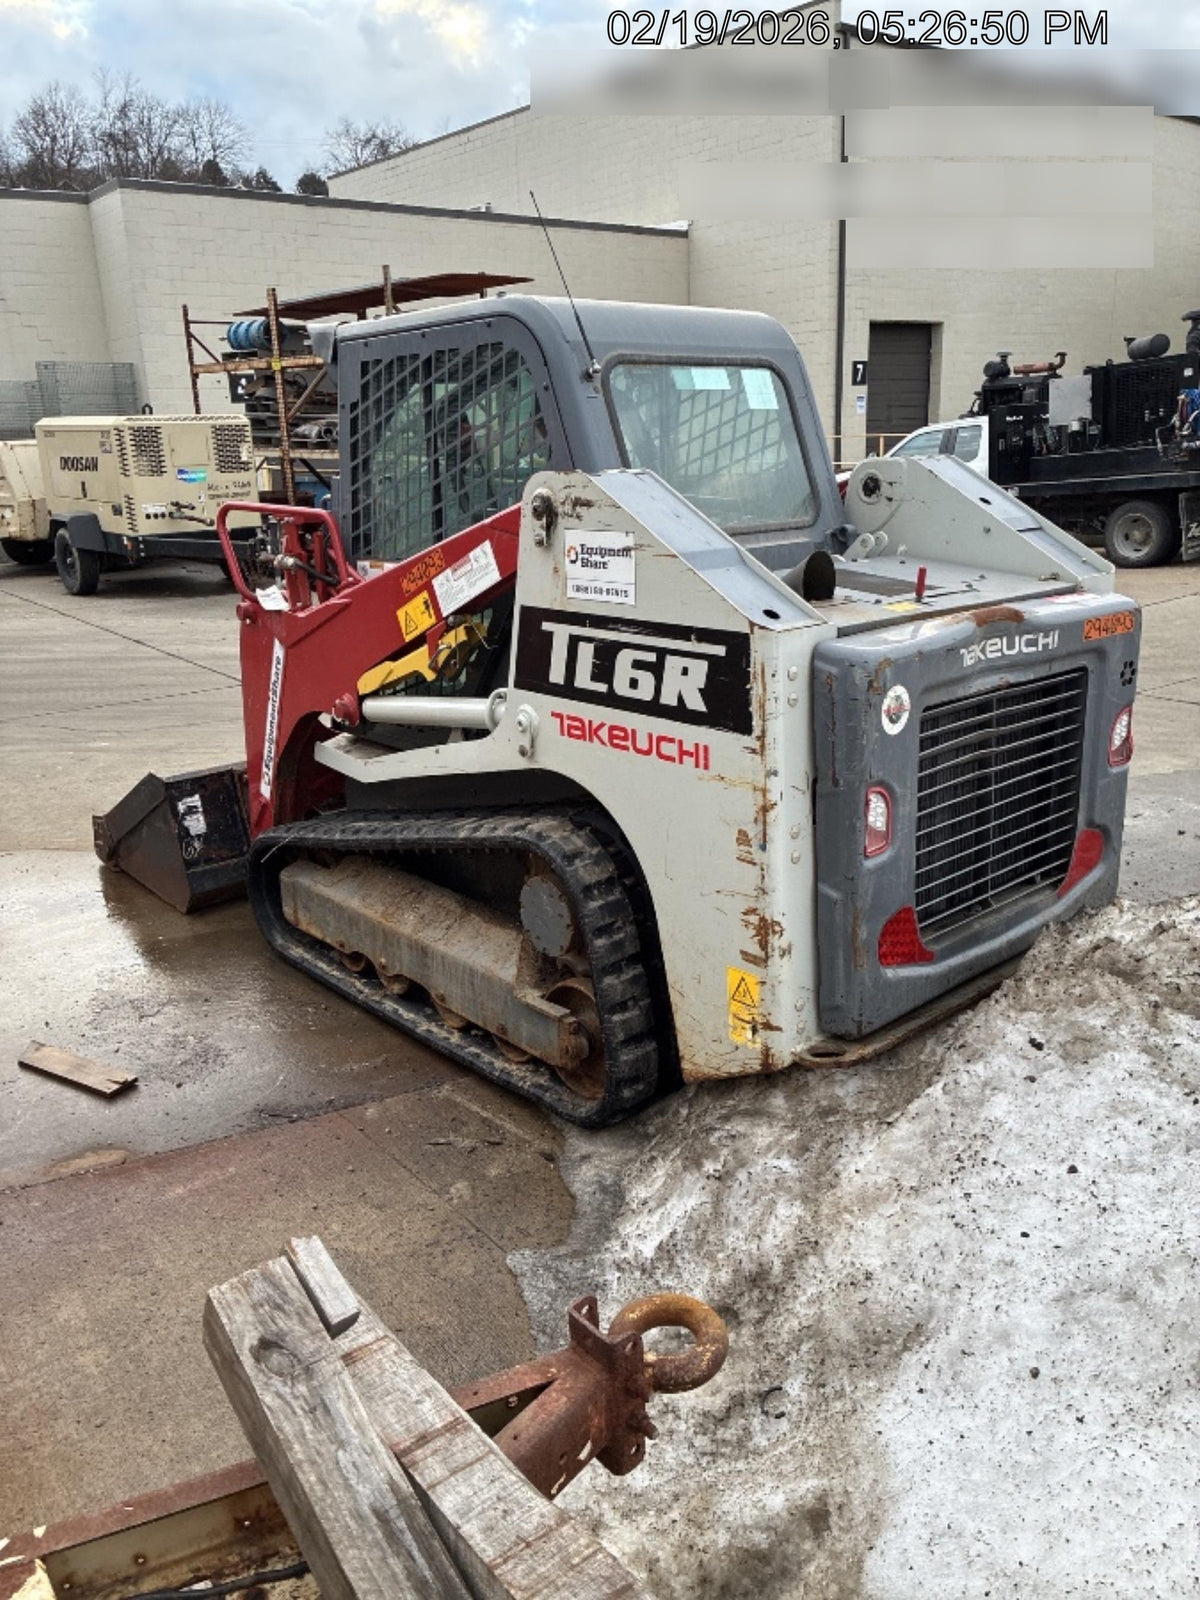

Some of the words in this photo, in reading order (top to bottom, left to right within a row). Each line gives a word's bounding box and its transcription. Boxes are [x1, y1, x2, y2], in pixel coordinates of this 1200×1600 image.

[856, 363, 864, 383] 7
[60, 456, 98, 472] DOOSAN
[579, 543, 632, 559] Equipment
[581, 557, 609, 570] Share
[541, 621, 726, 712] TL6R
